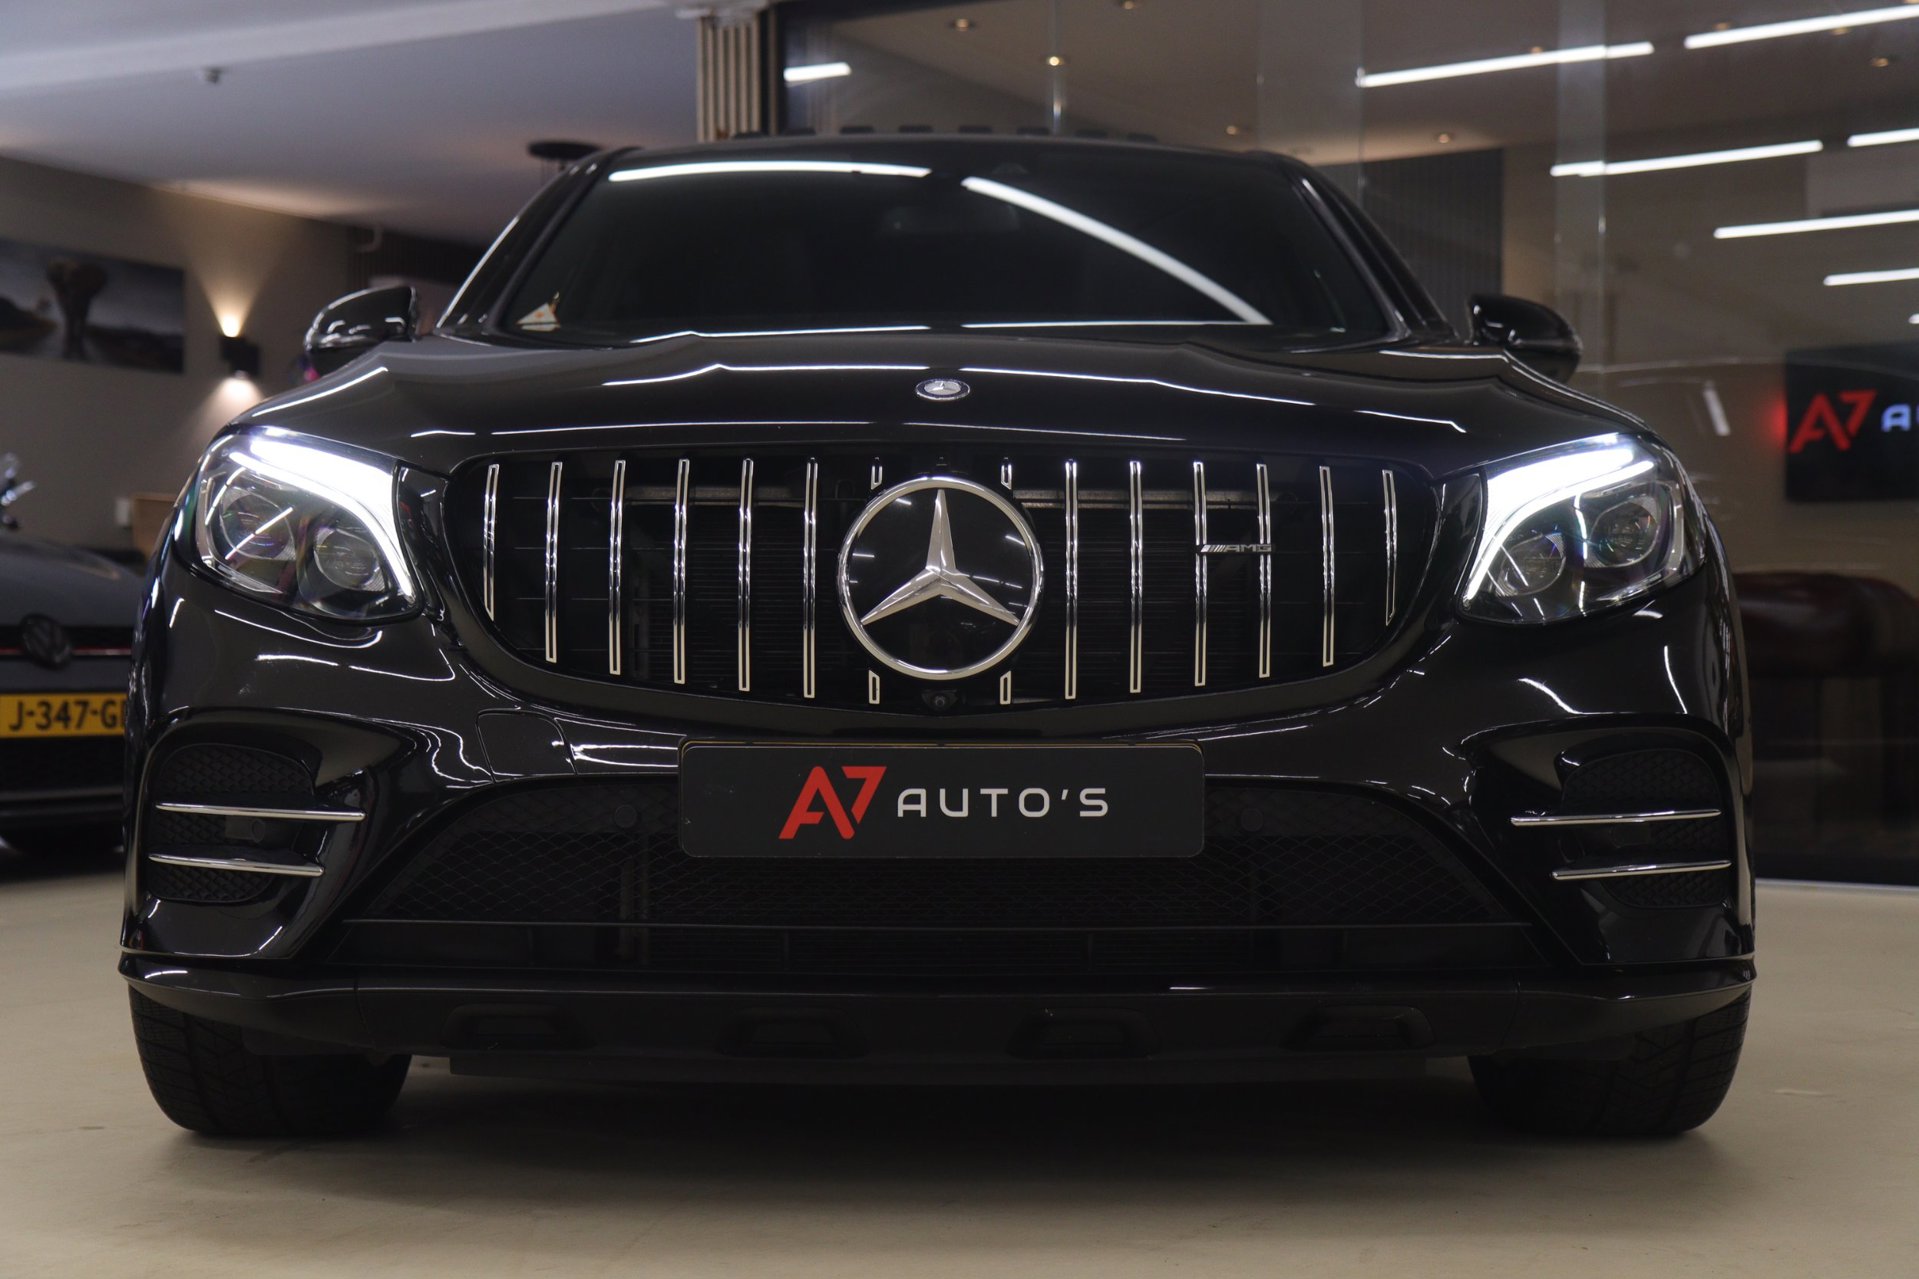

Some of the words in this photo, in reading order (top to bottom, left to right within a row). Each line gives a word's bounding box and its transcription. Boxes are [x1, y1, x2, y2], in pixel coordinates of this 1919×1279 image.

[1790, 390, 1876, 454] A7
[1880, 403, 1919, 432] A
[779, 766, 887, 840] A7
[897, 788, 1108, 817] AUTO'S
